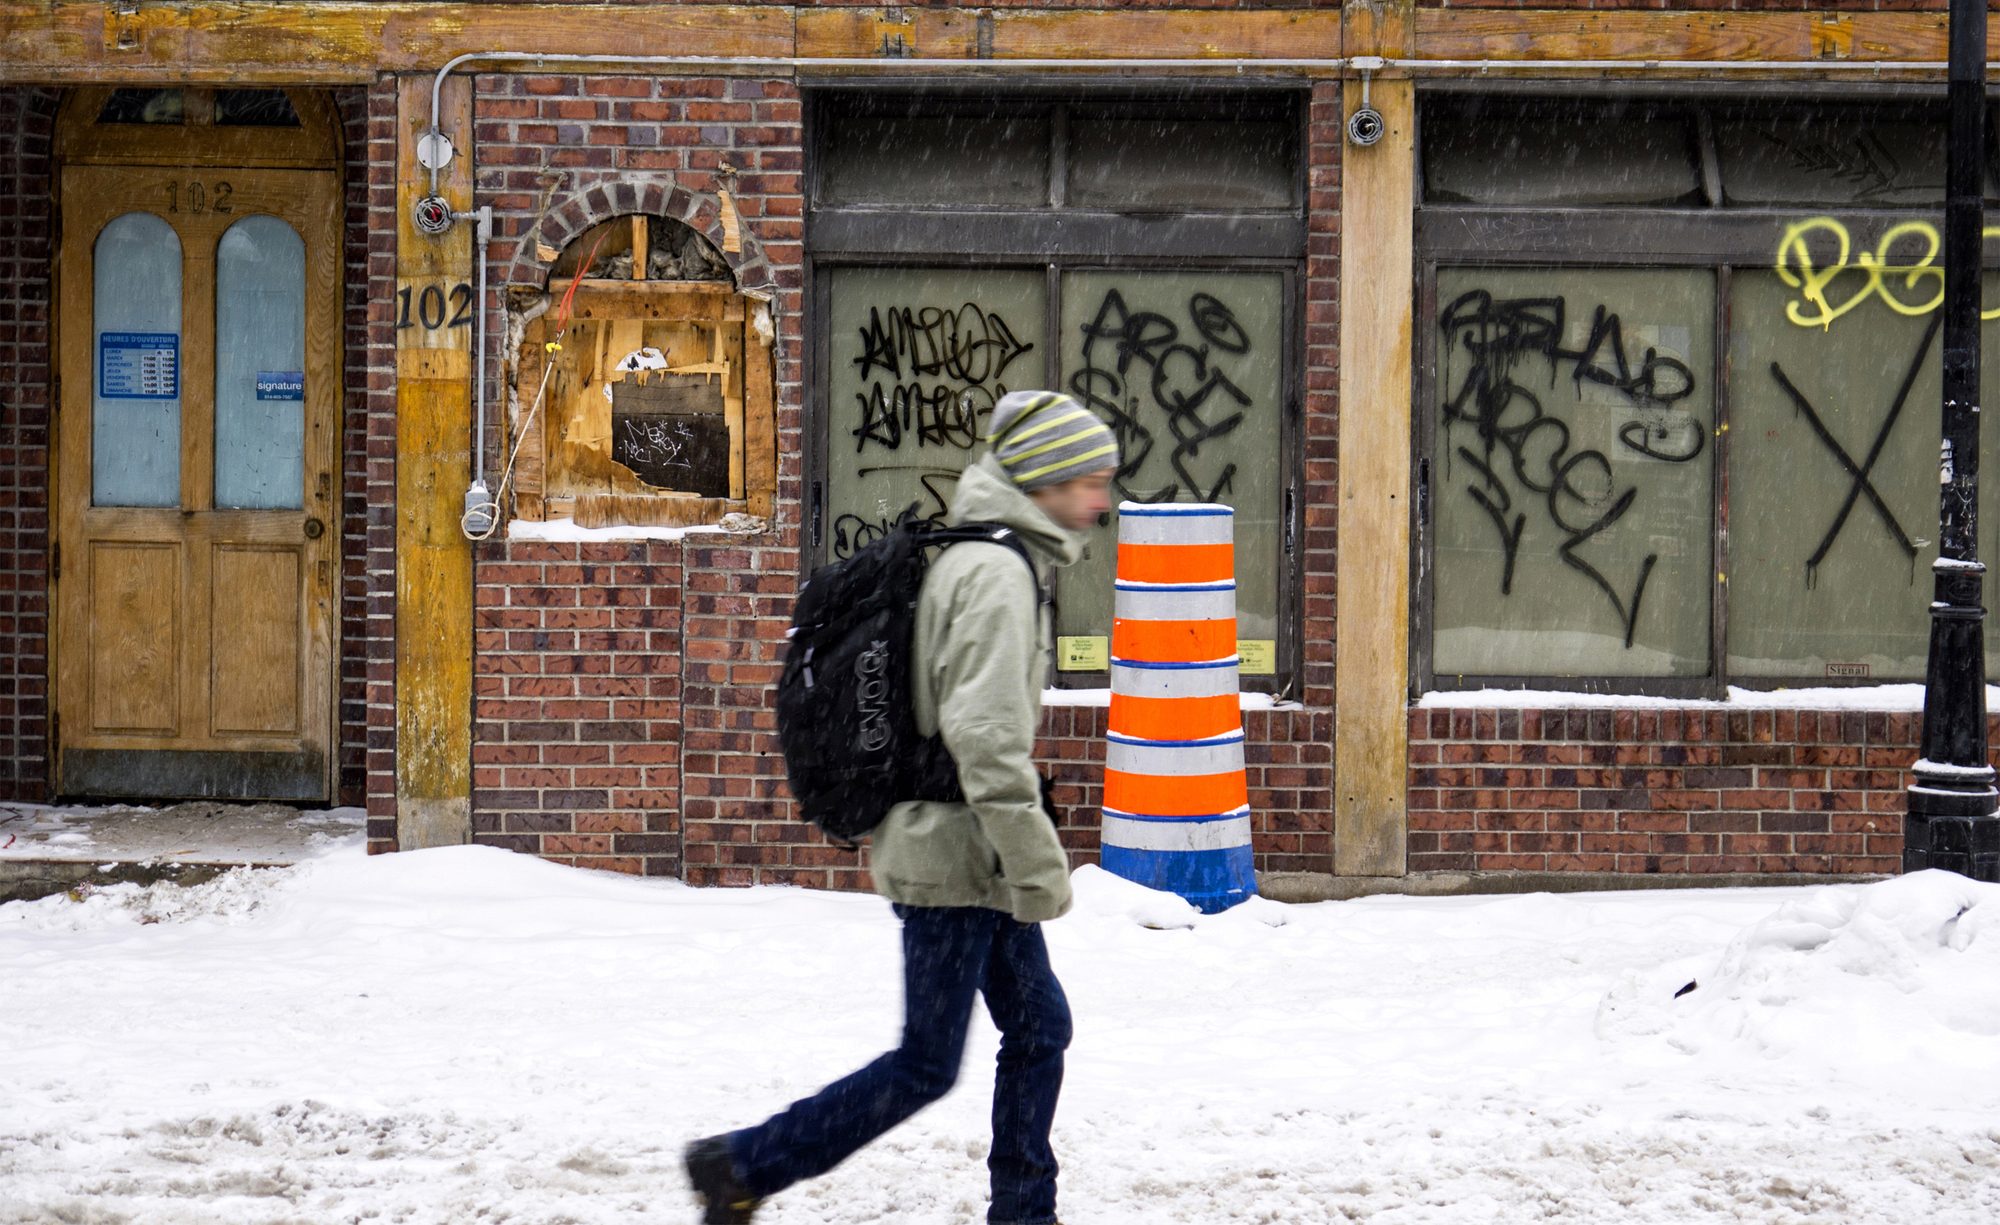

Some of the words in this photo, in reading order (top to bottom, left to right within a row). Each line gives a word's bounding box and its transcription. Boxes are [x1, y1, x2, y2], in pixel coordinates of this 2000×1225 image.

[166, 181, 233, 214] 102
[396, 283, 474, 330] 102
[103, 335, 129, 343] HEURES
[131, 336, 176, 344] D'OUVERTURE
[257, 381, 302, 392] signature
[1830, 665, 1865, 675] Signal
